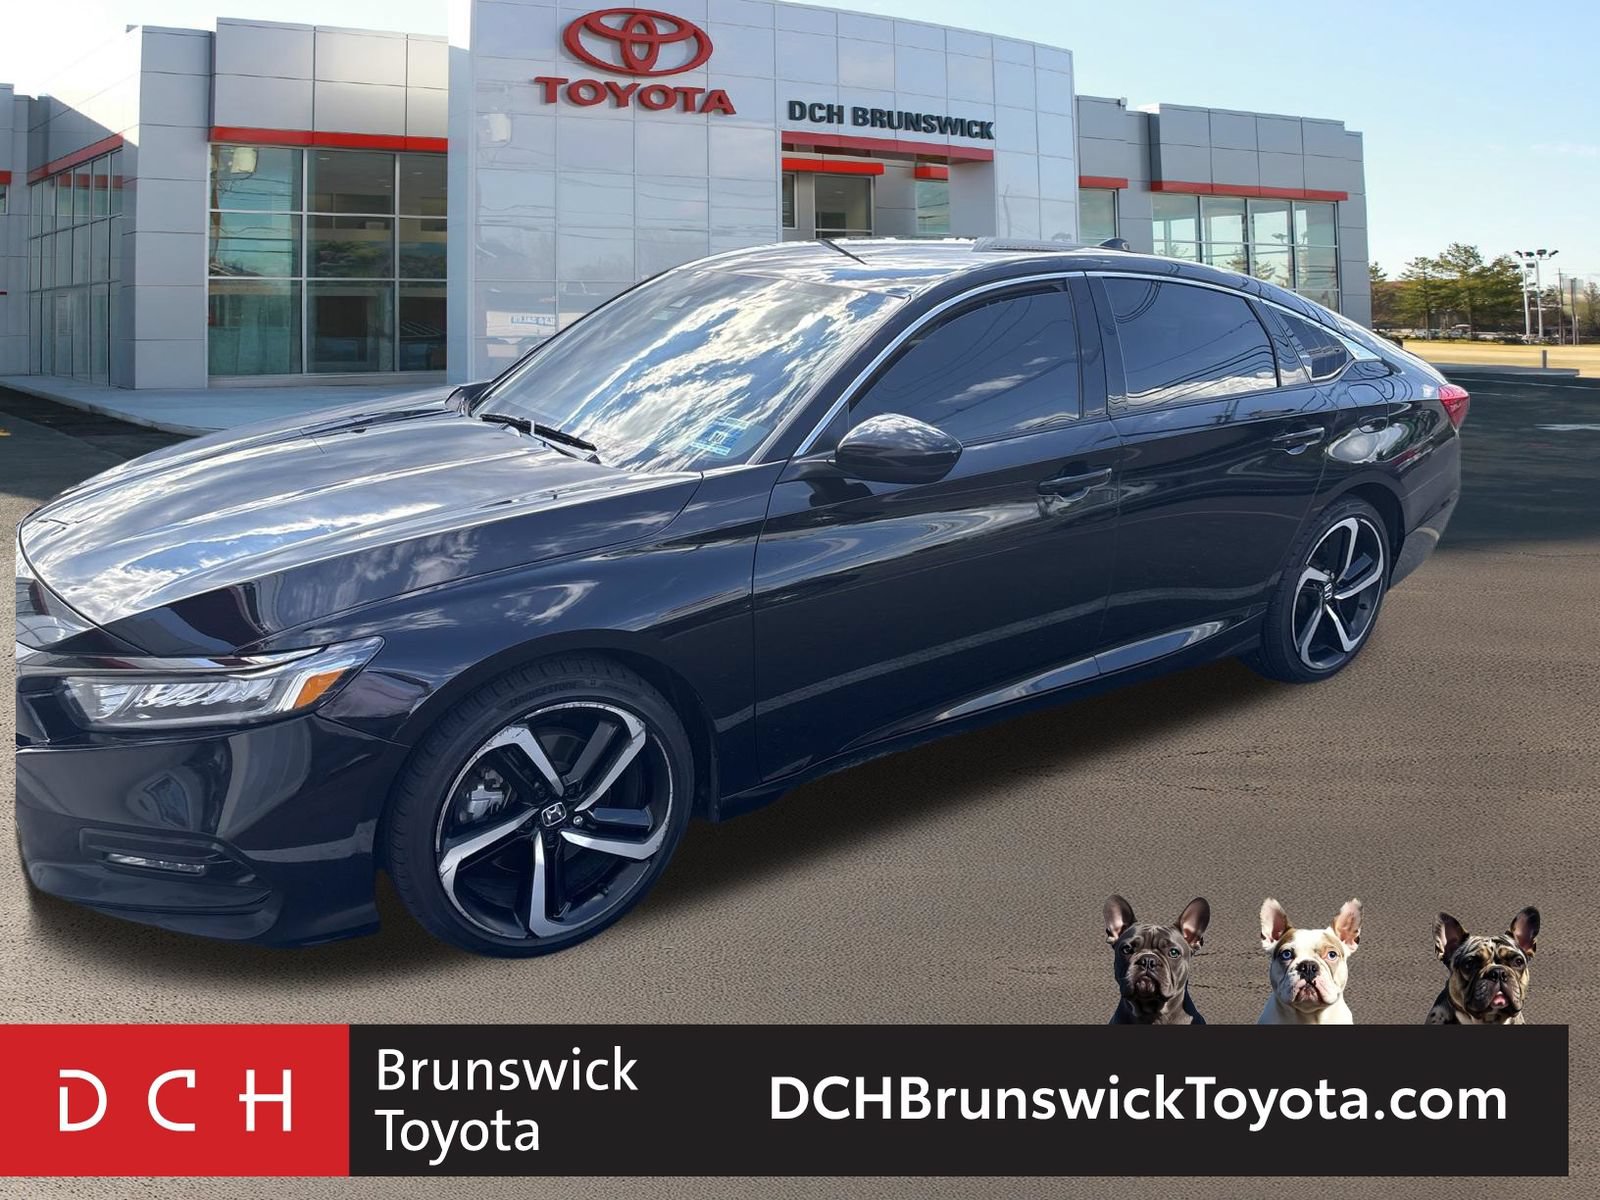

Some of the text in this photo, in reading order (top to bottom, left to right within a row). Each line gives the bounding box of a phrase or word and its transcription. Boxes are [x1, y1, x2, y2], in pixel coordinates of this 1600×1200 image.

[534, 76, 736, 115] TOYOTA
[787, 100, 995, 140] DCH BRUNSWICK
